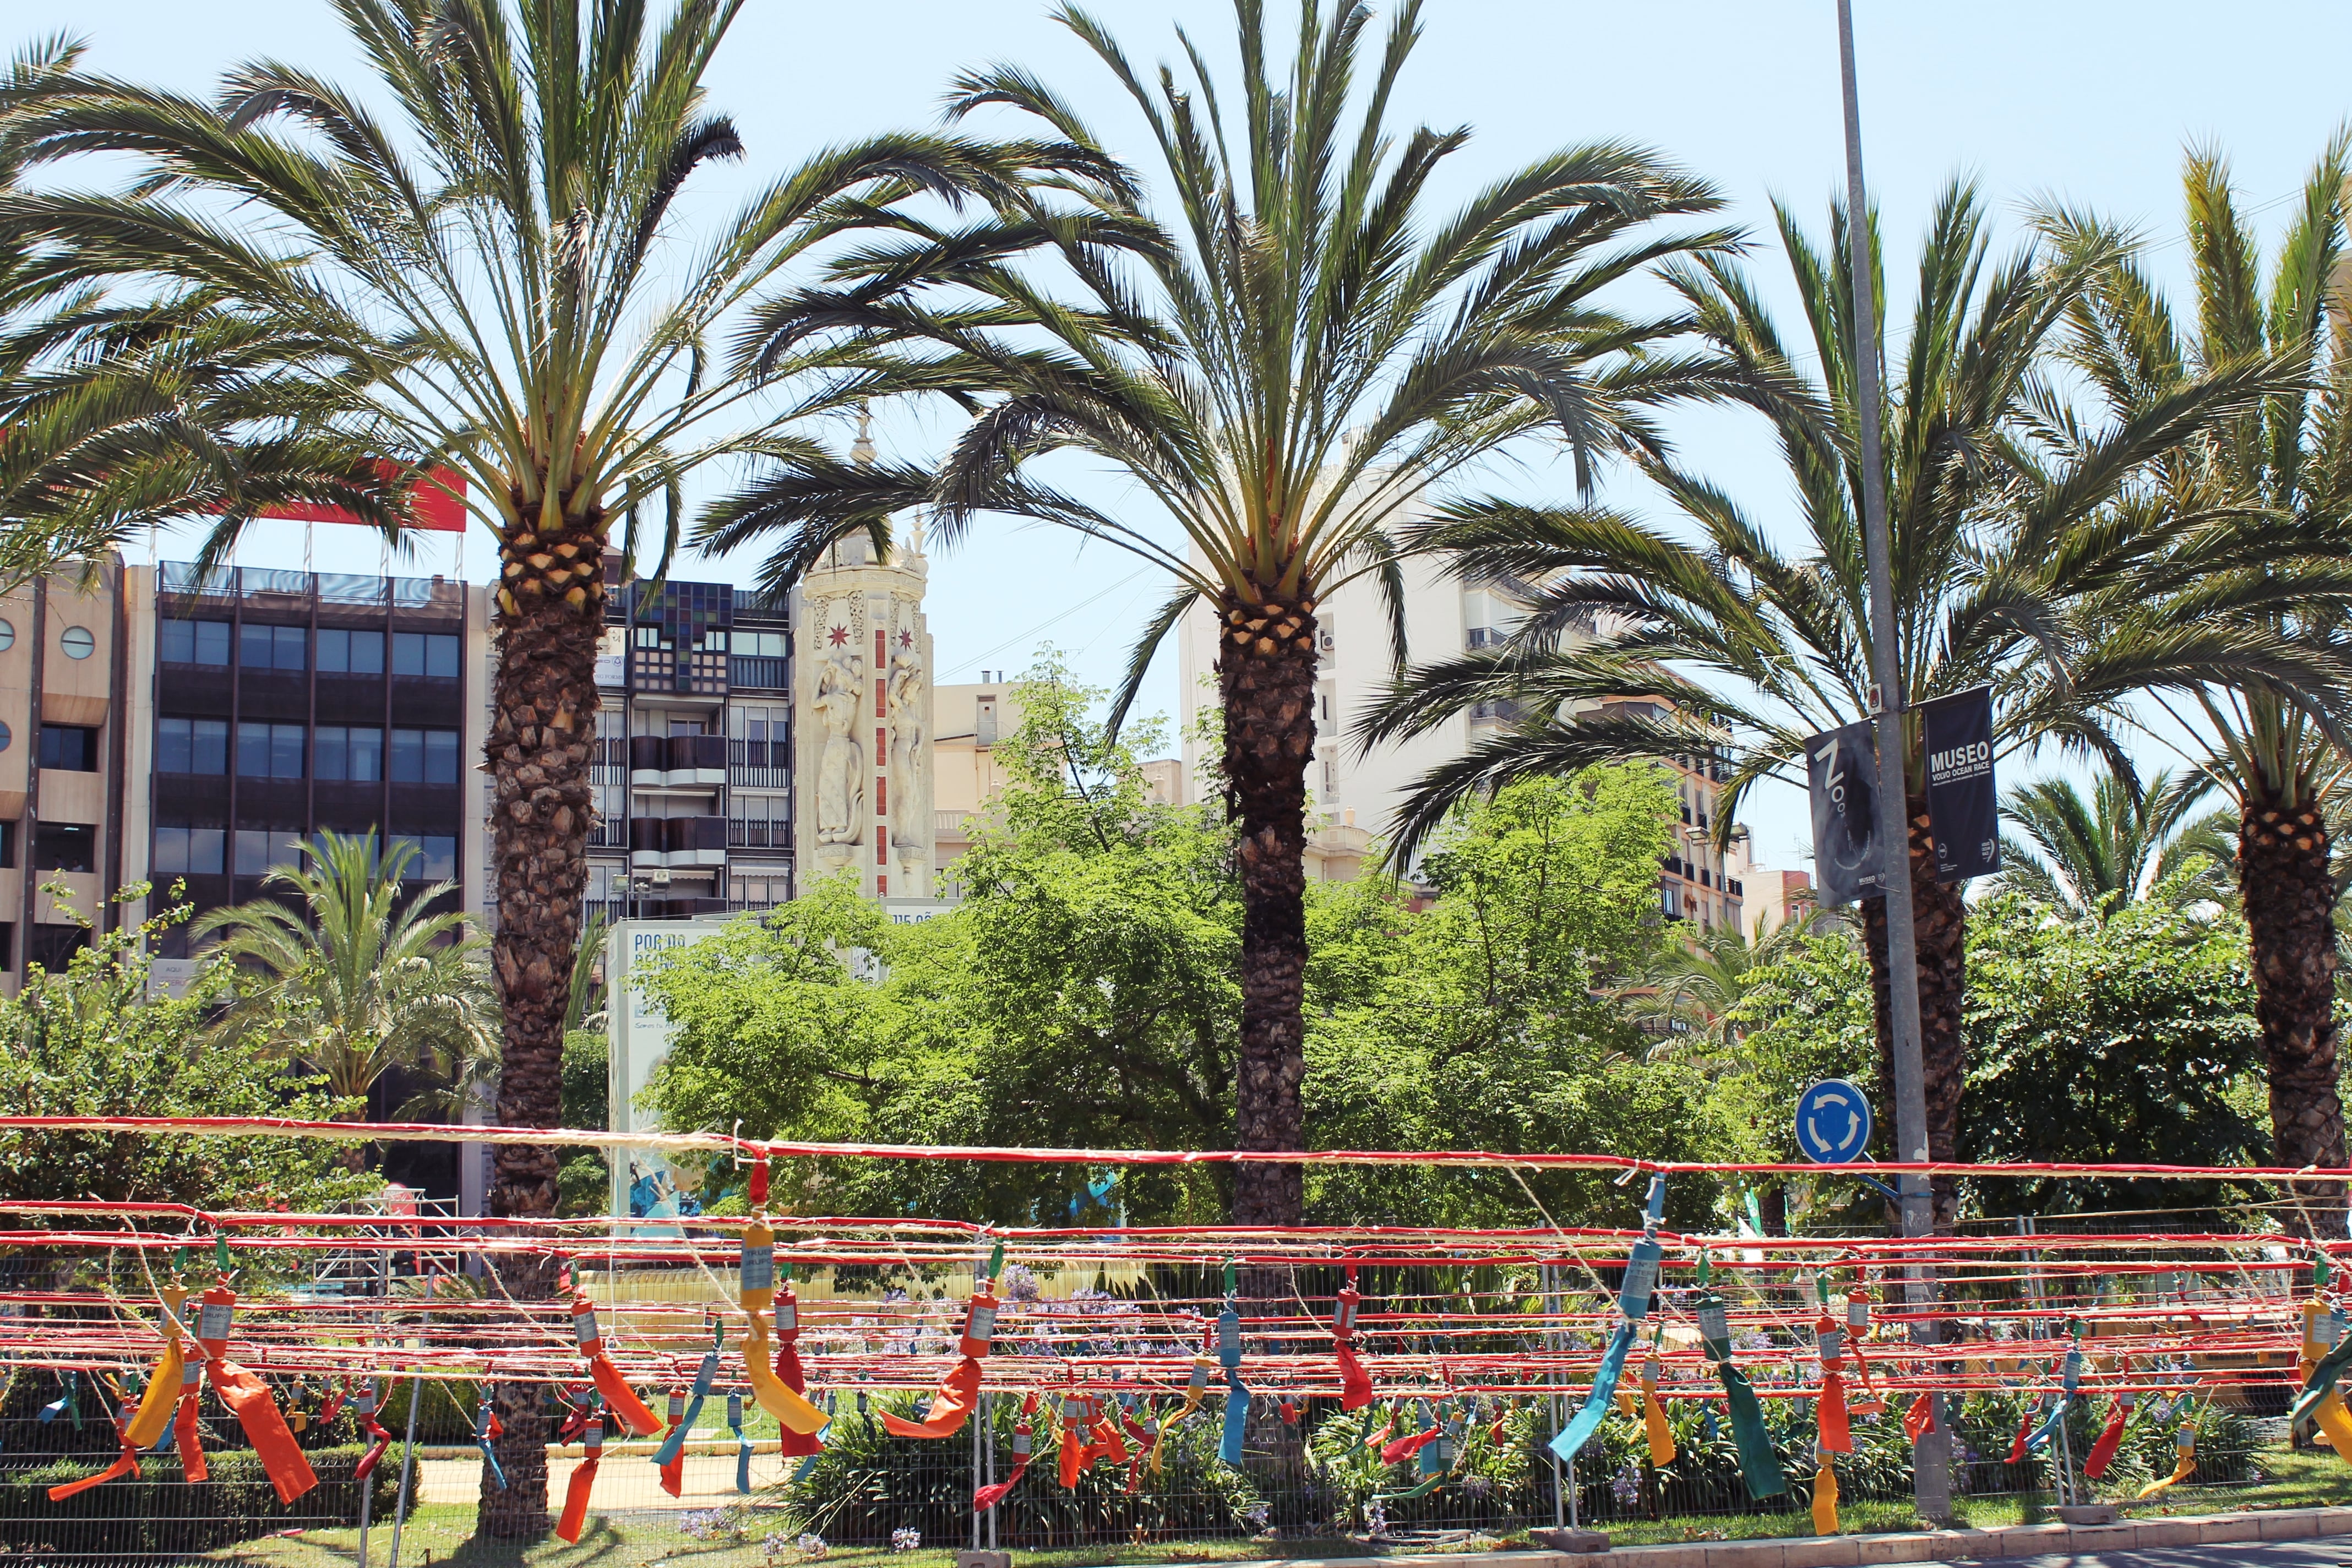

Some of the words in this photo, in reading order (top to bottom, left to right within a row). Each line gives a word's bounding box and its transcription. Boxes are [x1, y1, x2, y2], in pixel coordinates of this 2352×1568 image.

[1931, 741, 1989, 772] MUSEO
[1932, 771, 1951, 781] VOLVO
[1952, 765, 1972, 776] OCEAN
[1973, 760, 1990, 771] RACE
